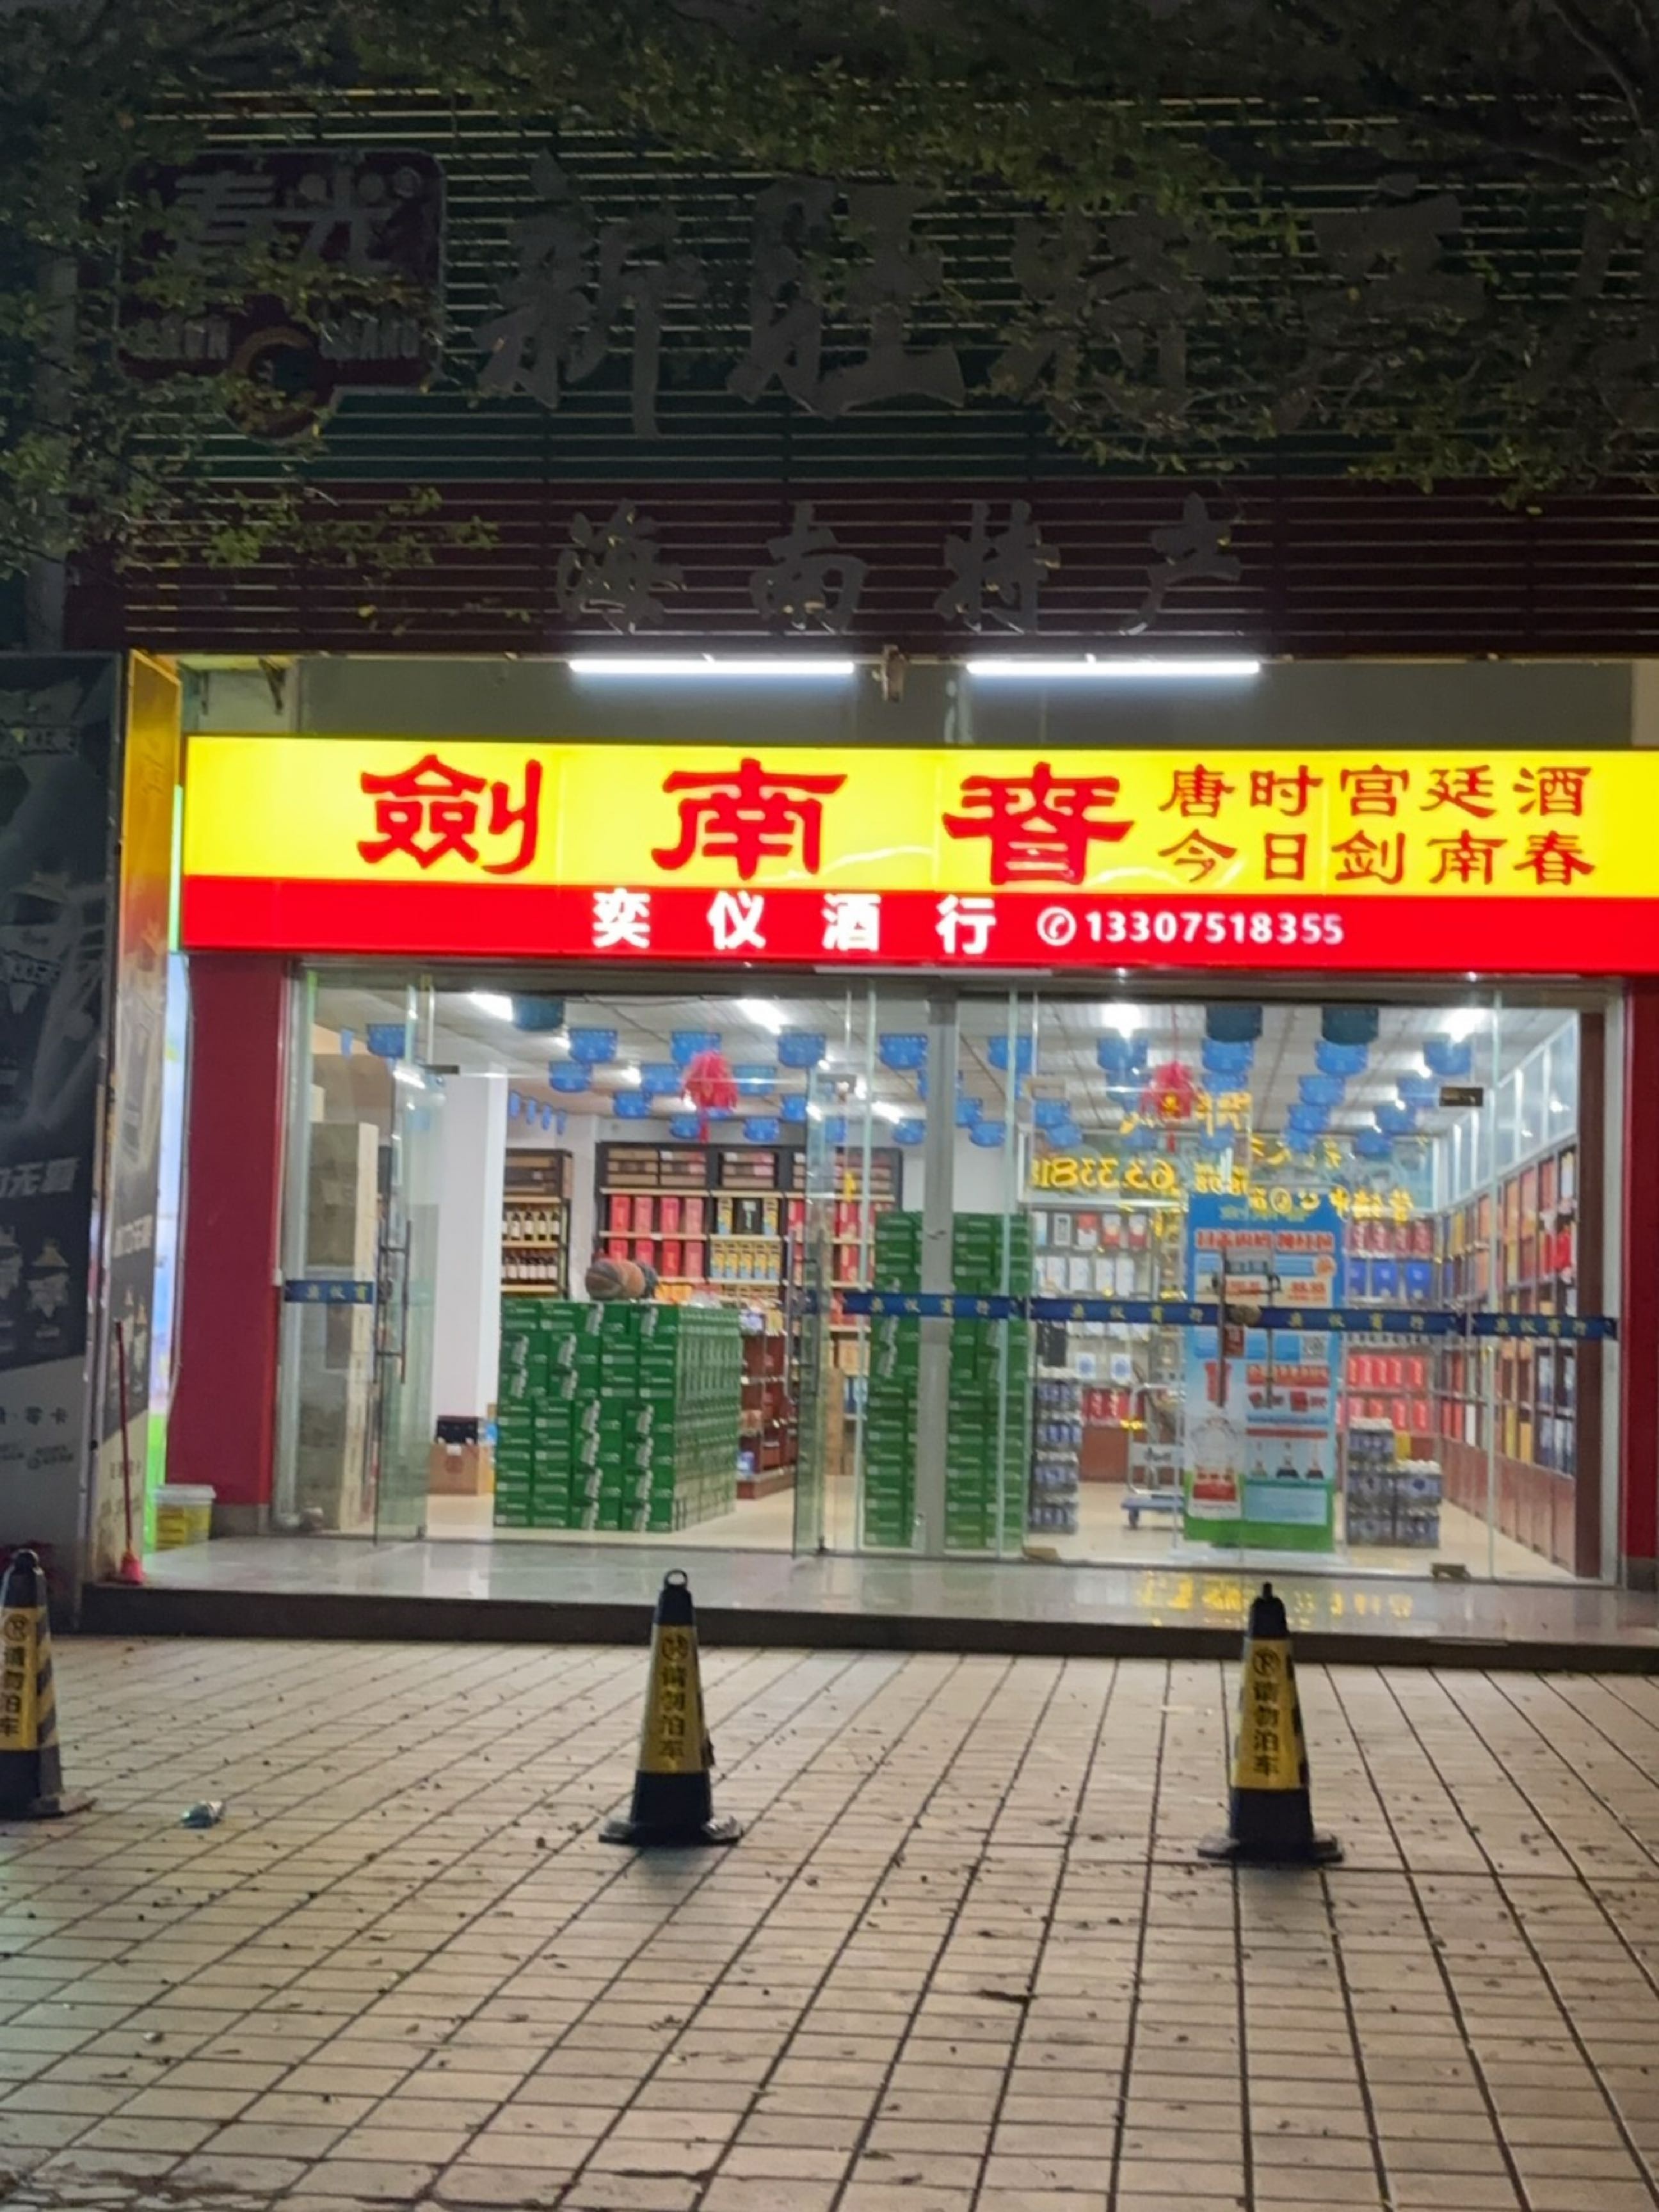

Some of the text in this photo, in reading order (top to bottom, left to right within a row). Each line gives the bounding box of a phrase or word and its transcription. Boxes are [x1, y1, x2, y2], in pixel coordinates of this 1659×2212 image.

[1166, 764, 1590, 819] 唐时宫廷酒
[1164, 830, 1594, 886] 今日剑南春
[592, 888, 997, 954] 奕仪酒行
[1086, 910, 1343, 945] 13307518355
